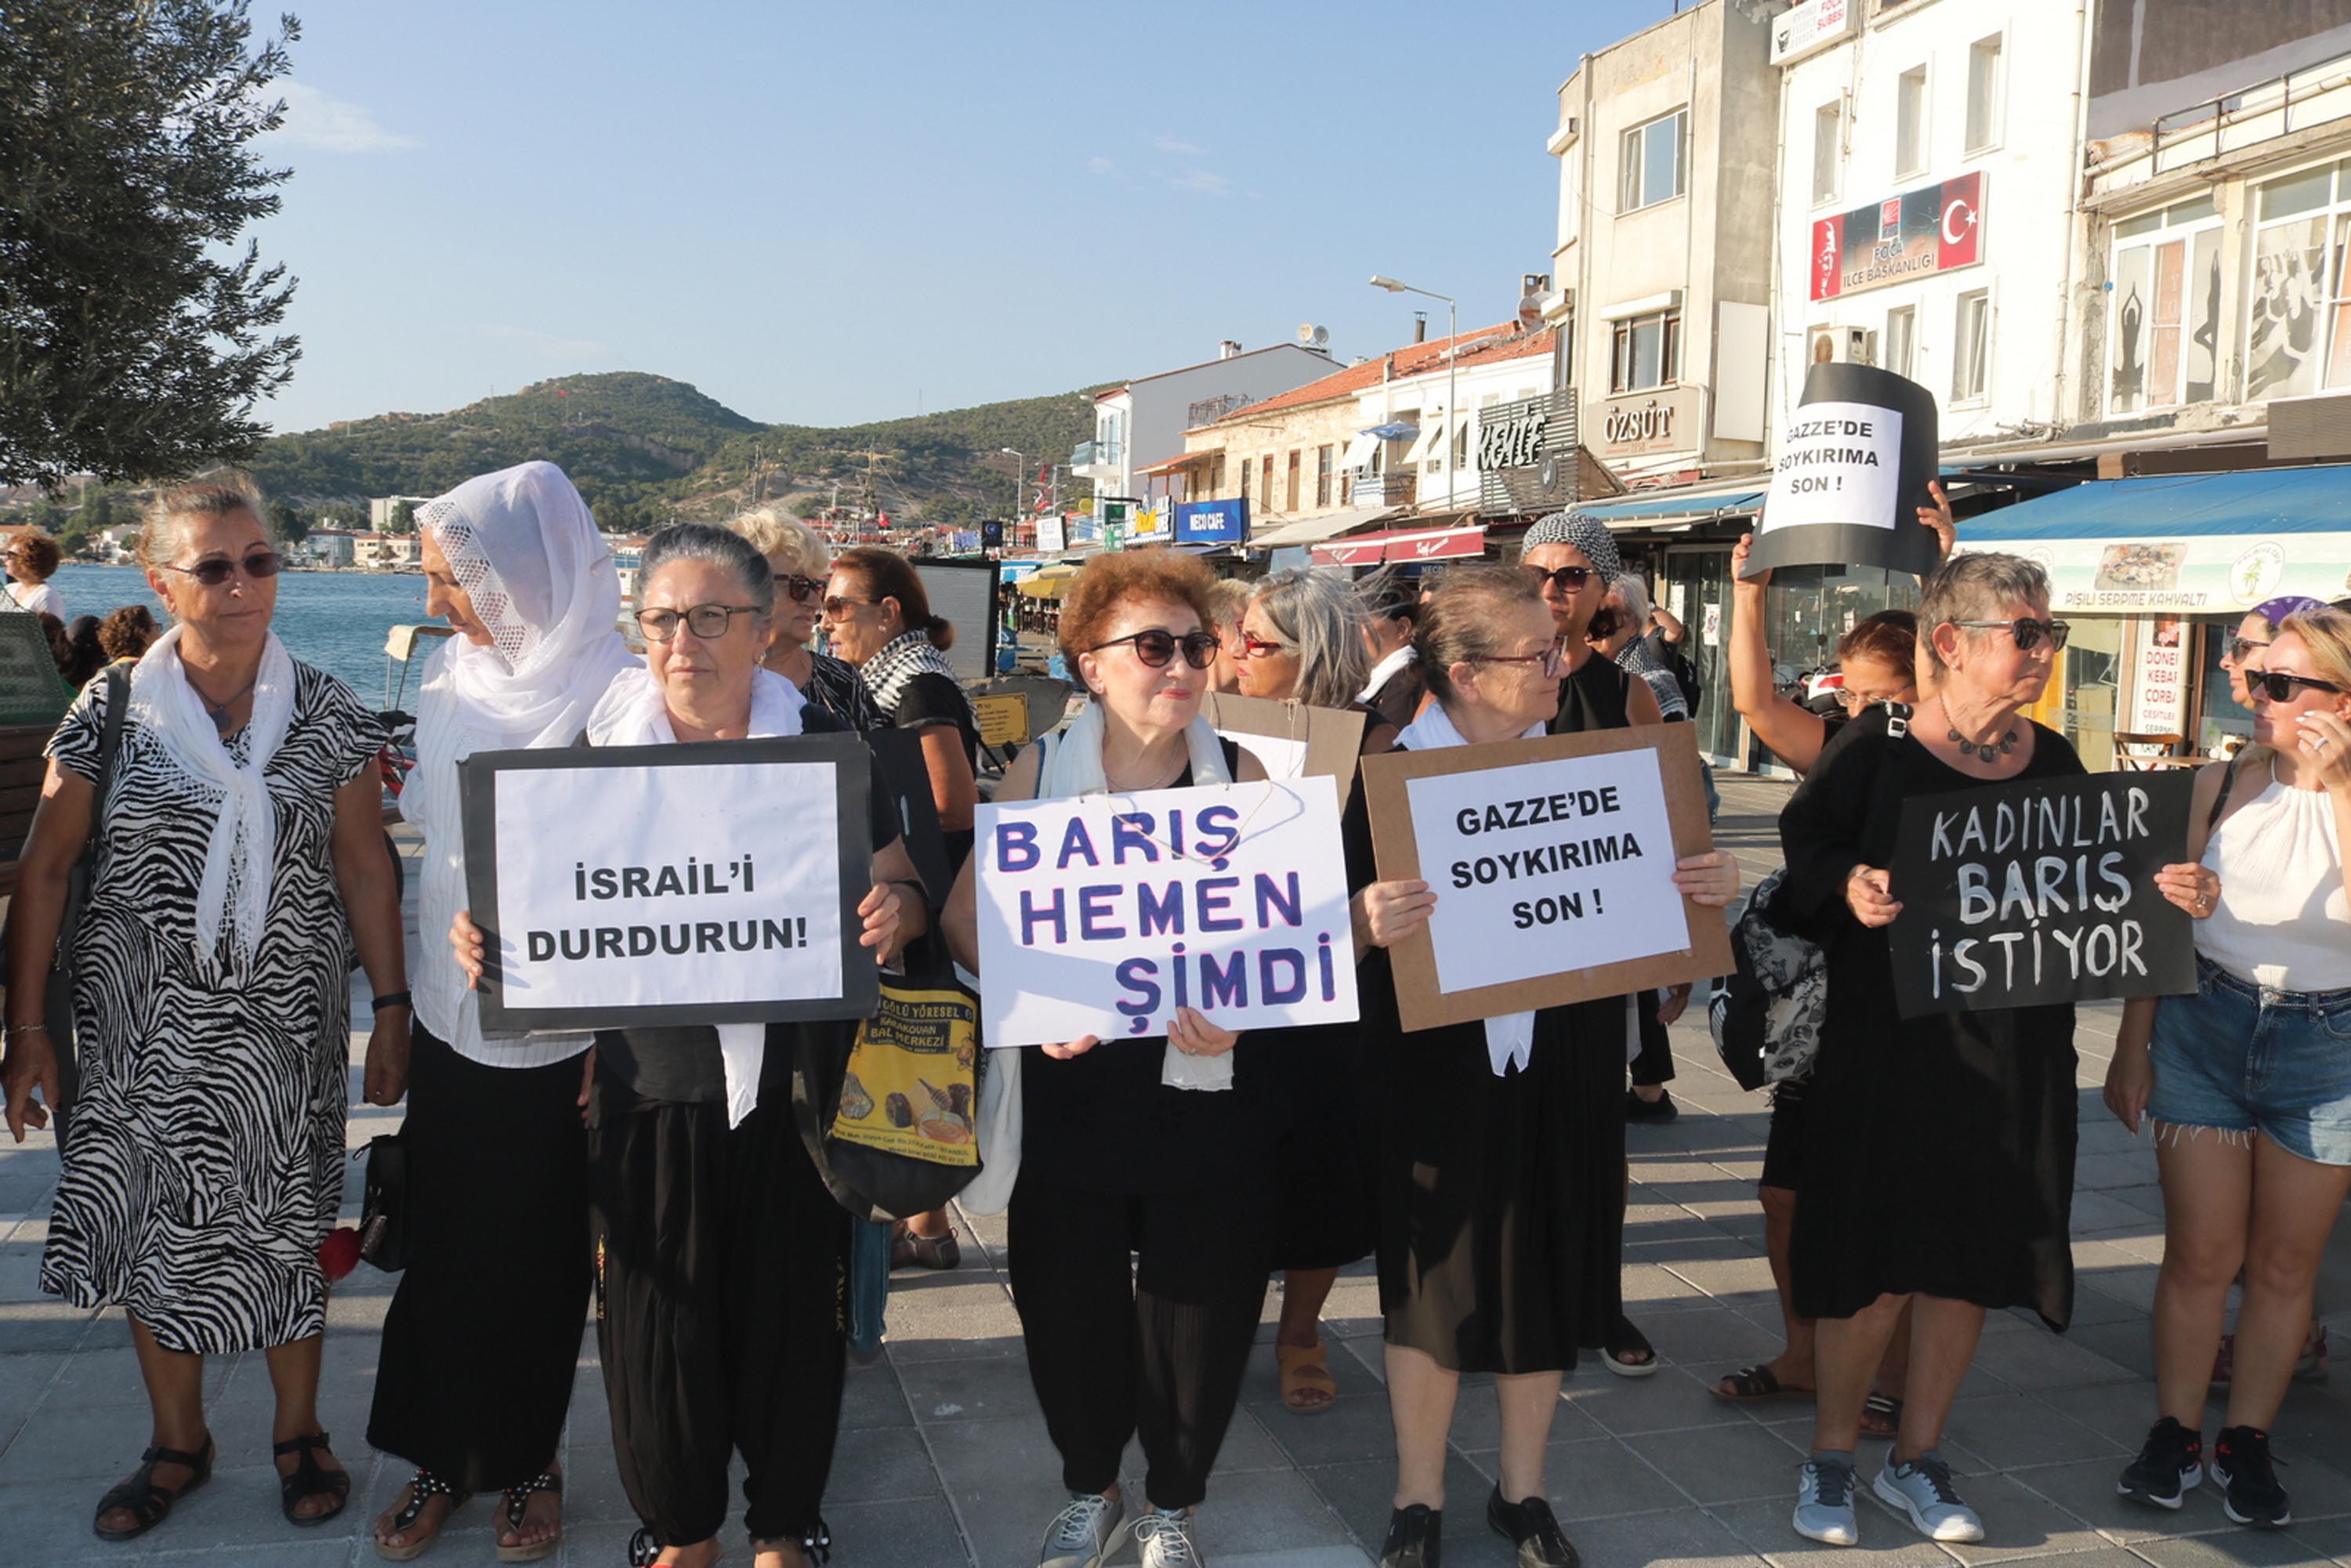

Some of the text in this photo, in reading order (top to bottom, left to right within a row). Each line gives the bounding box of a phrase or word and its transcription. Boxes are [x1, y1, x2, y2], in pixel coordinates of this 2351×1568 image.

[1604, 400, 1673, 444] ÖZSÜT
[1786, 419, 1873, 444] GAZZE'DE
[1778, 447, 1879, 473] SOYKIRIMA
[1790, 476, 1842, 494] SON !
[1208, 512, 1225, 530] CAFE
[2099, 592, 2146, 607] SERPME
[2148, 592, 2208, 607] KAHVALTI
[1456, 785, 1621, 836] GAZZE'DE
[1931, 787, 2150, 862] KADINLAR
[995, 806, 1241, 872] BARIŞ
[1451, 832, 1643, 889] SOYKIRIMA
[574, 853, 755, 900] İSRAİL'İ
[1020, 871, 1302, 945] HEMEN
[1512, 888, 1604, 929] SON !
[527, 917, 807, 962] DURDURUN!
[1931, 918, 2149, 1000] İSTİYOR
[1115, 931, 1336, 1034] ŞİMDİ
[912, 1004, 960, 1018] YÖRESEL
[871, 1027, 893, 1038] BAL
[895, 1032, 944, 1048] MERKEZİ
